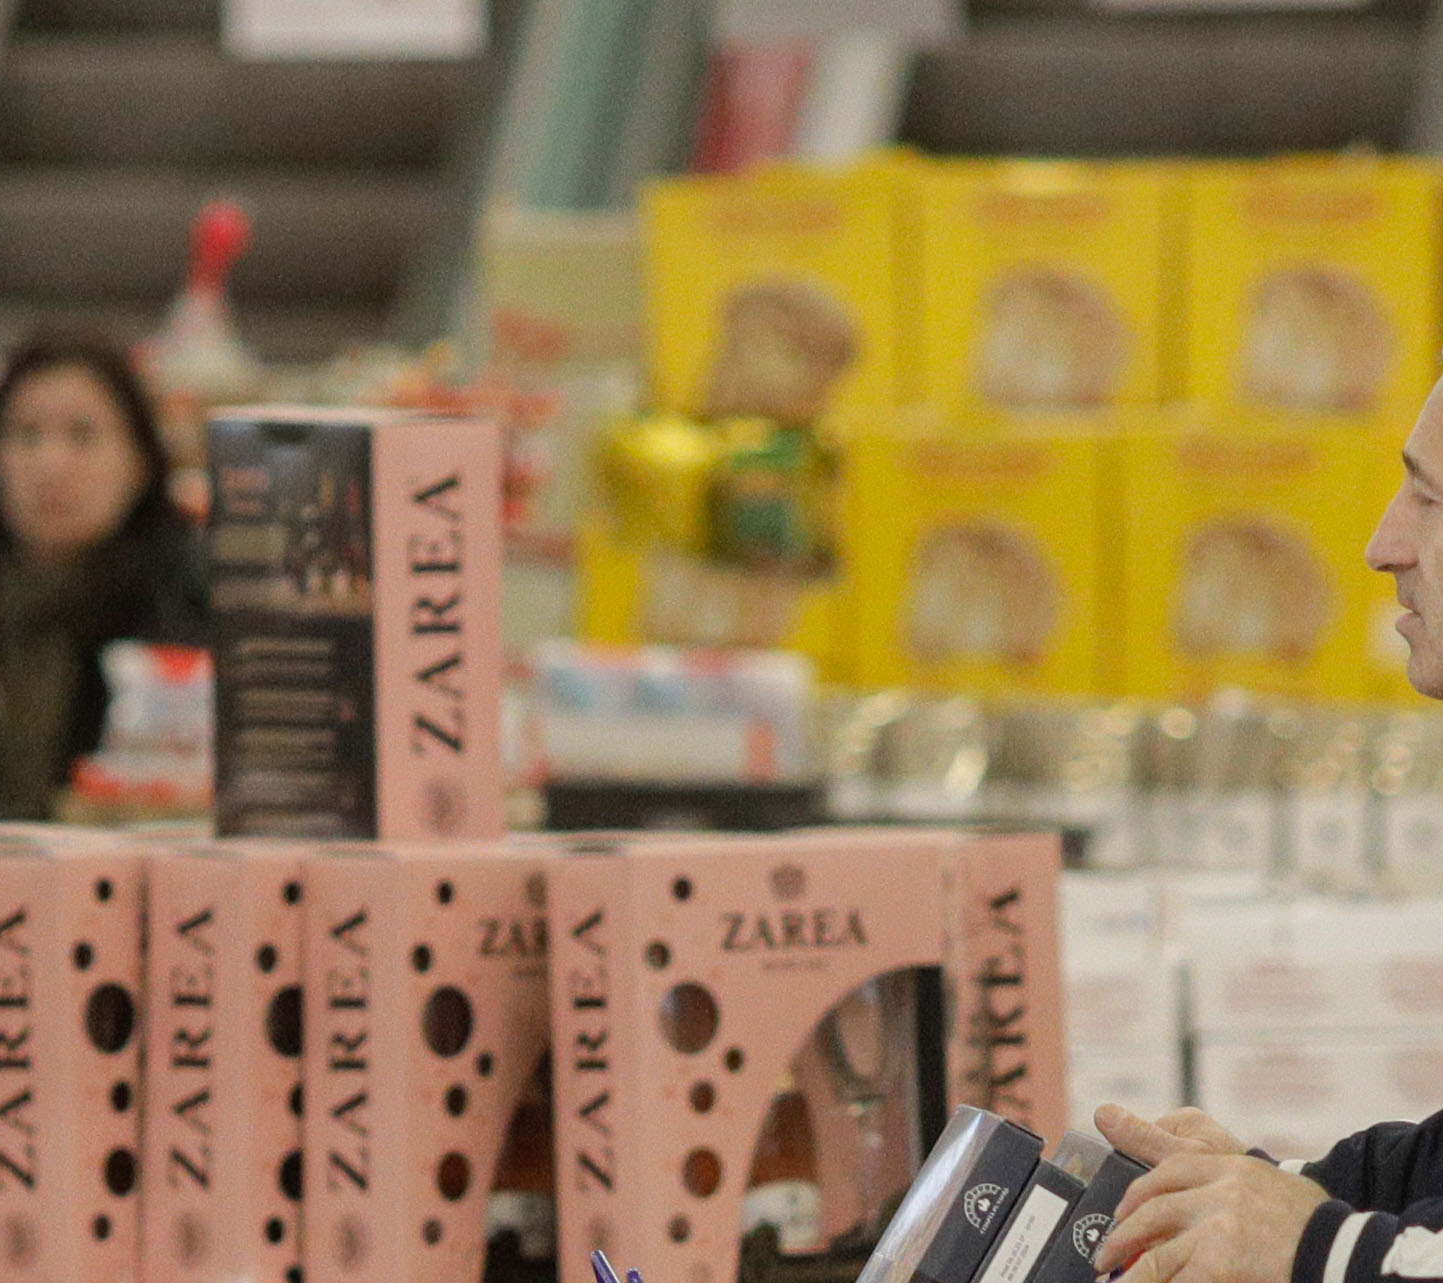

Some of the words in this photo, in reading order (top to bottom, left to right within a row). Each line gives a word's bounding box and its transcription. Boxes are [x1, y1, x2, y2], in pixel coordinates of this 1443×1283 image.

[414, 473, 463, 753] ZAREA
[168, 908, 213, 1191] ZAREA
[328, 910, 370, 1192] ZAREA
[571, 908, 613, 1193] ZAREA
[721, 908, 868, 952] ZAREA
[980, 890, 1026, 1110] AREA
